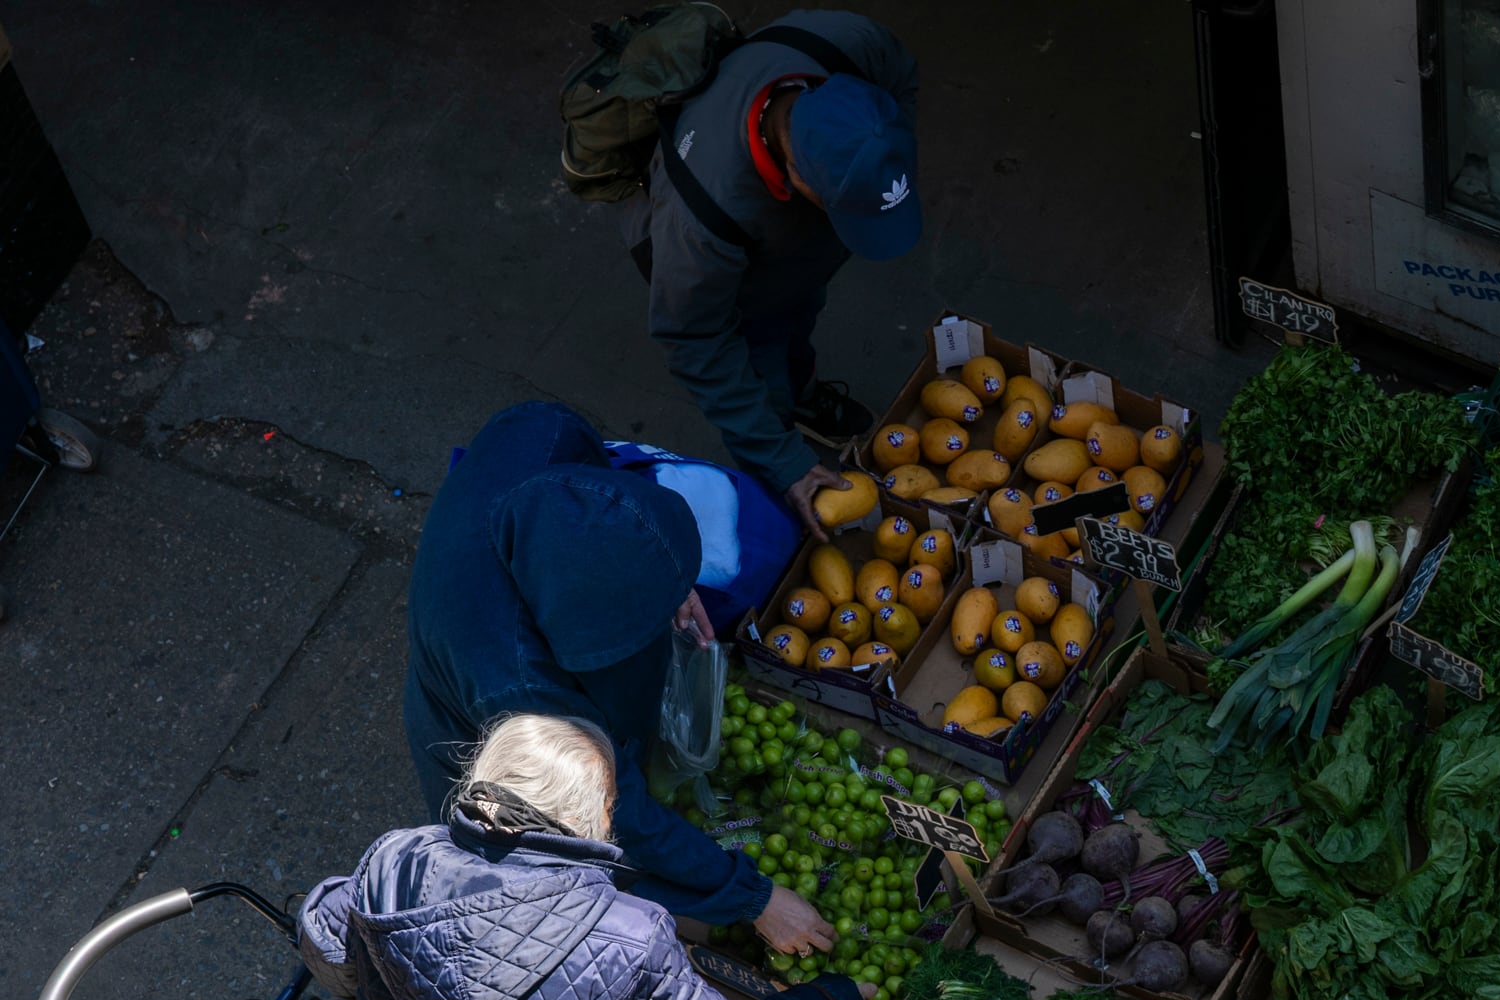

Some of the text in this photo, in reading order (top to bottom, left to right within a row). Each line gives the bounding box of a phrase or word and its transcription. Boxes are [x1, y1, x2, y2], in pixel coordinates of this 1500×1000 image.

[1243, 282, 1333, 323] CILANTRO
[1090, 536, 1158, 575] $2.99
[1098, 522, 1175, 561] BEETS
[886, 775, 911, 797] Grape
[896, 801, 959, 831] DILL
